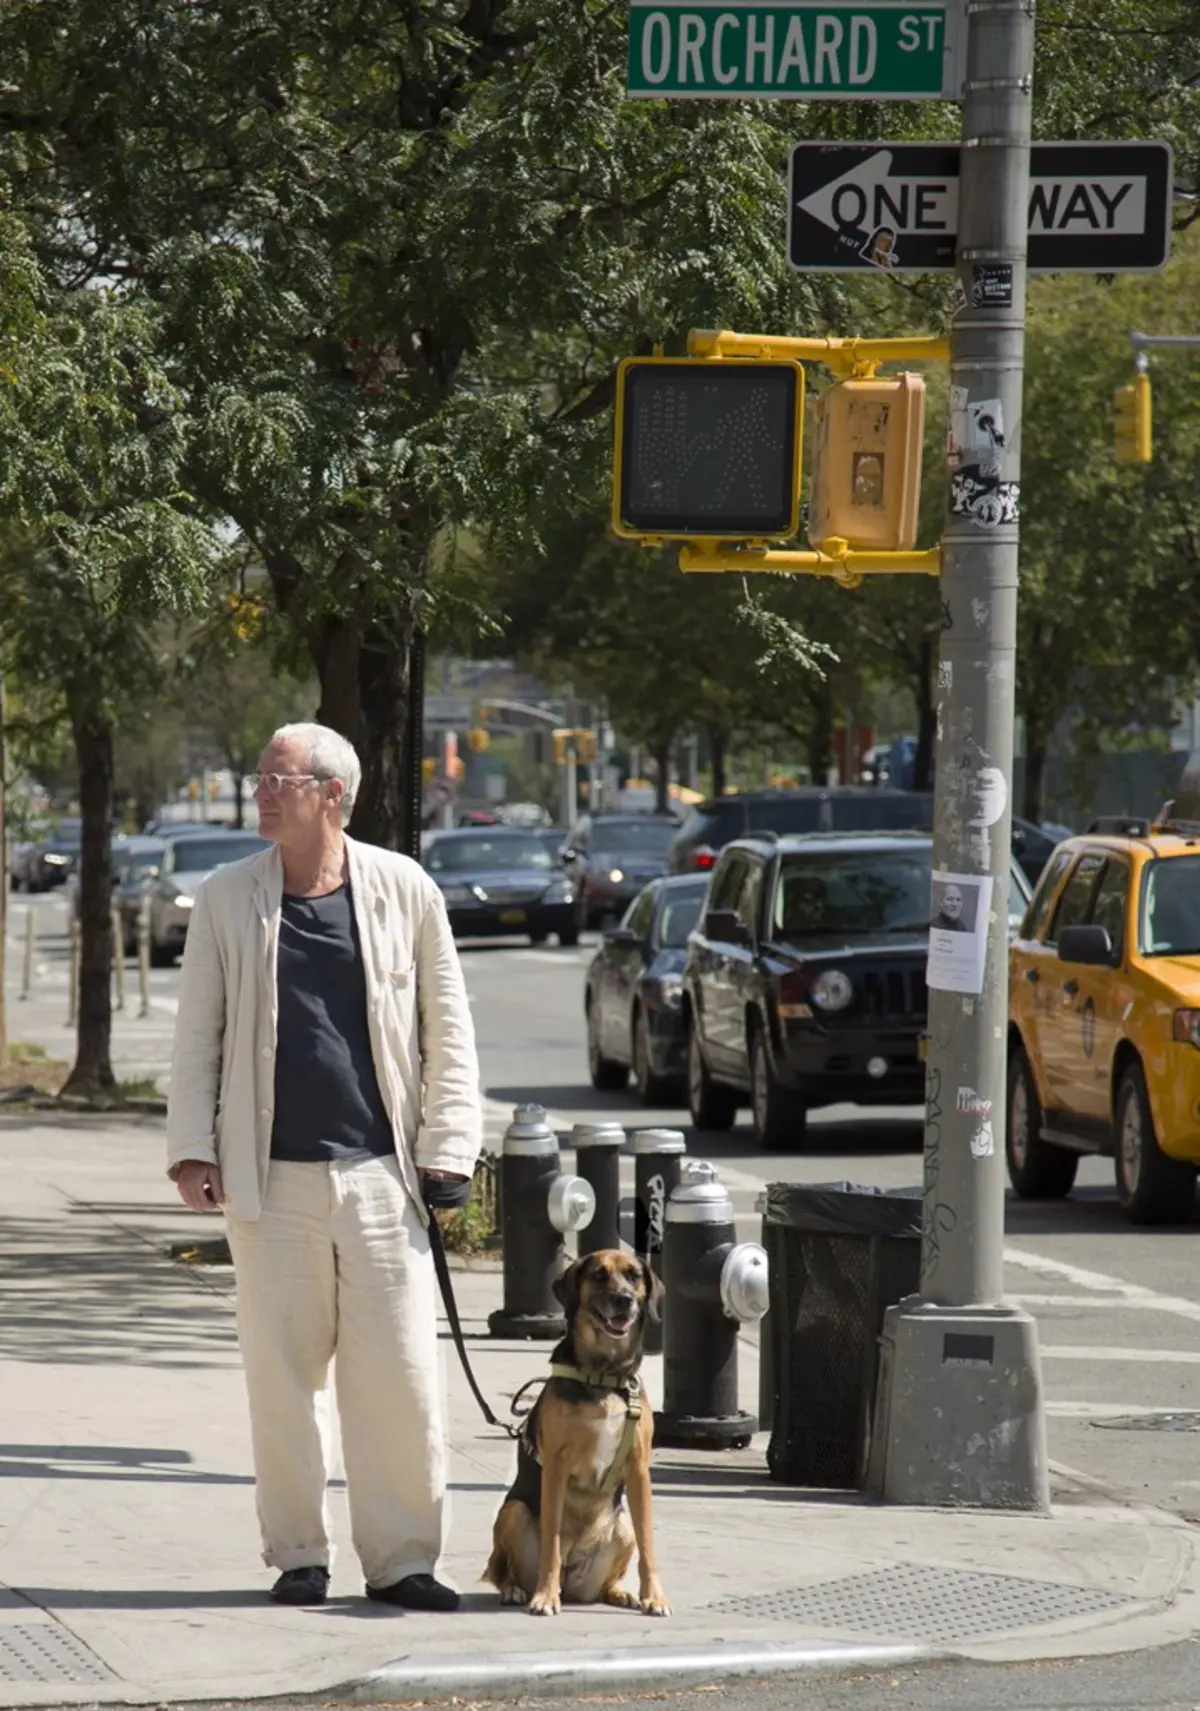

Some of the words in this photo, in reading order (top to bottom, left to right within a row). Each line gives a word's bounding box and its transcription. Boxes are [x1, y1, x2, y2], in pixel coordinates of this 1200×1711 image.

[641, 13, 878, 84] ORCHARD
[898, 16, 943, 52] ST
[832, 183, 947, 230] ONE
